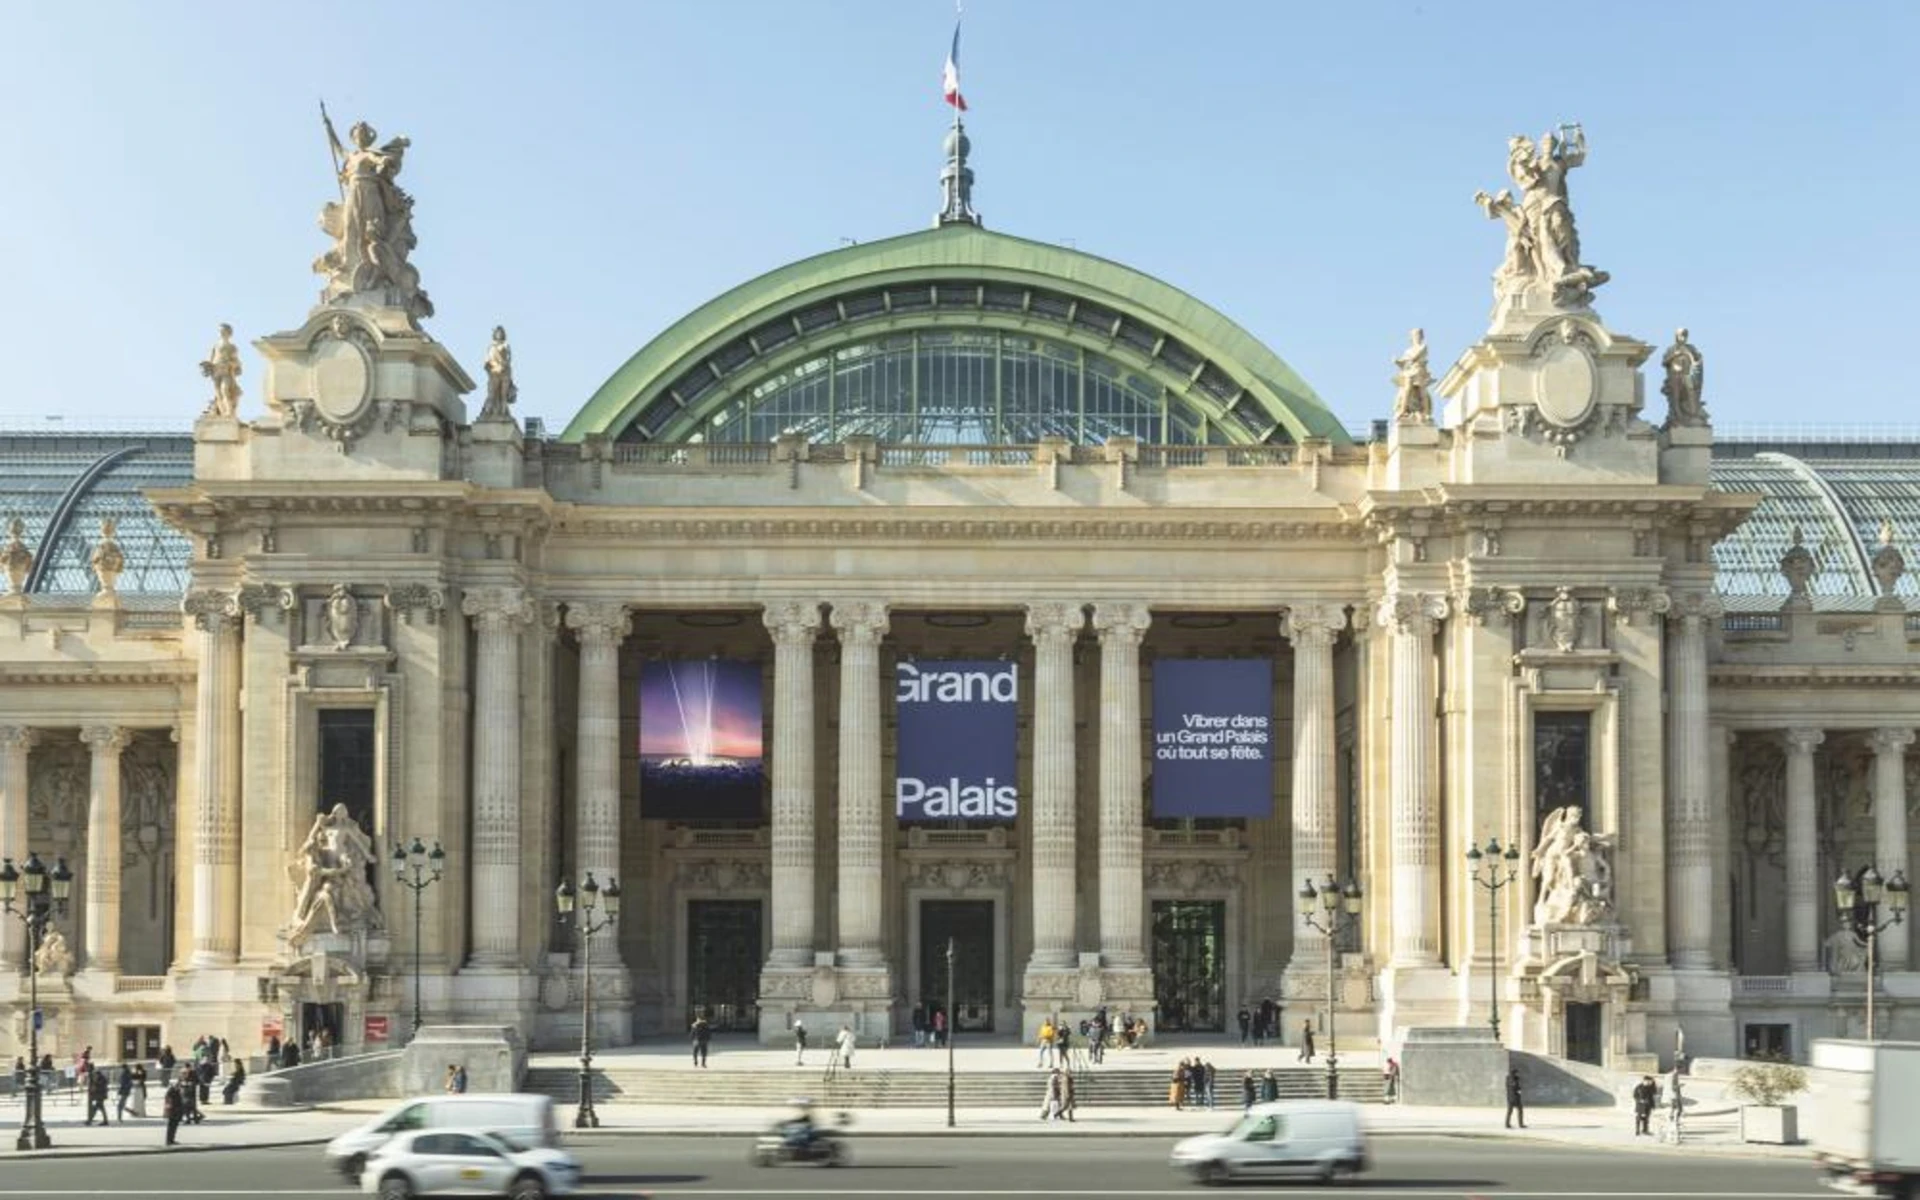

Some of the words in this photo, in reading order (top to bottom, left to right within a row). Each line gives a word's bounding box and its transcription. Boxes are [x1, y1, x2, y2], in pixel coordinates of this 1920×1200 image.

[896, 662, 1018, 702] Grand
[1182, 714, 1229, 728] Vibrer
[1230, 714, 1268, 728] dans
[1157, 732, 1176, 743] un
[1177, 729, 1224, 744] Grand
[1225, 729, 1268, 744] Palais
[1178, 746, 1208, 760] tout
[1209, 748, 1229, 760] se
[896, 777, 1018, 817] Palais
